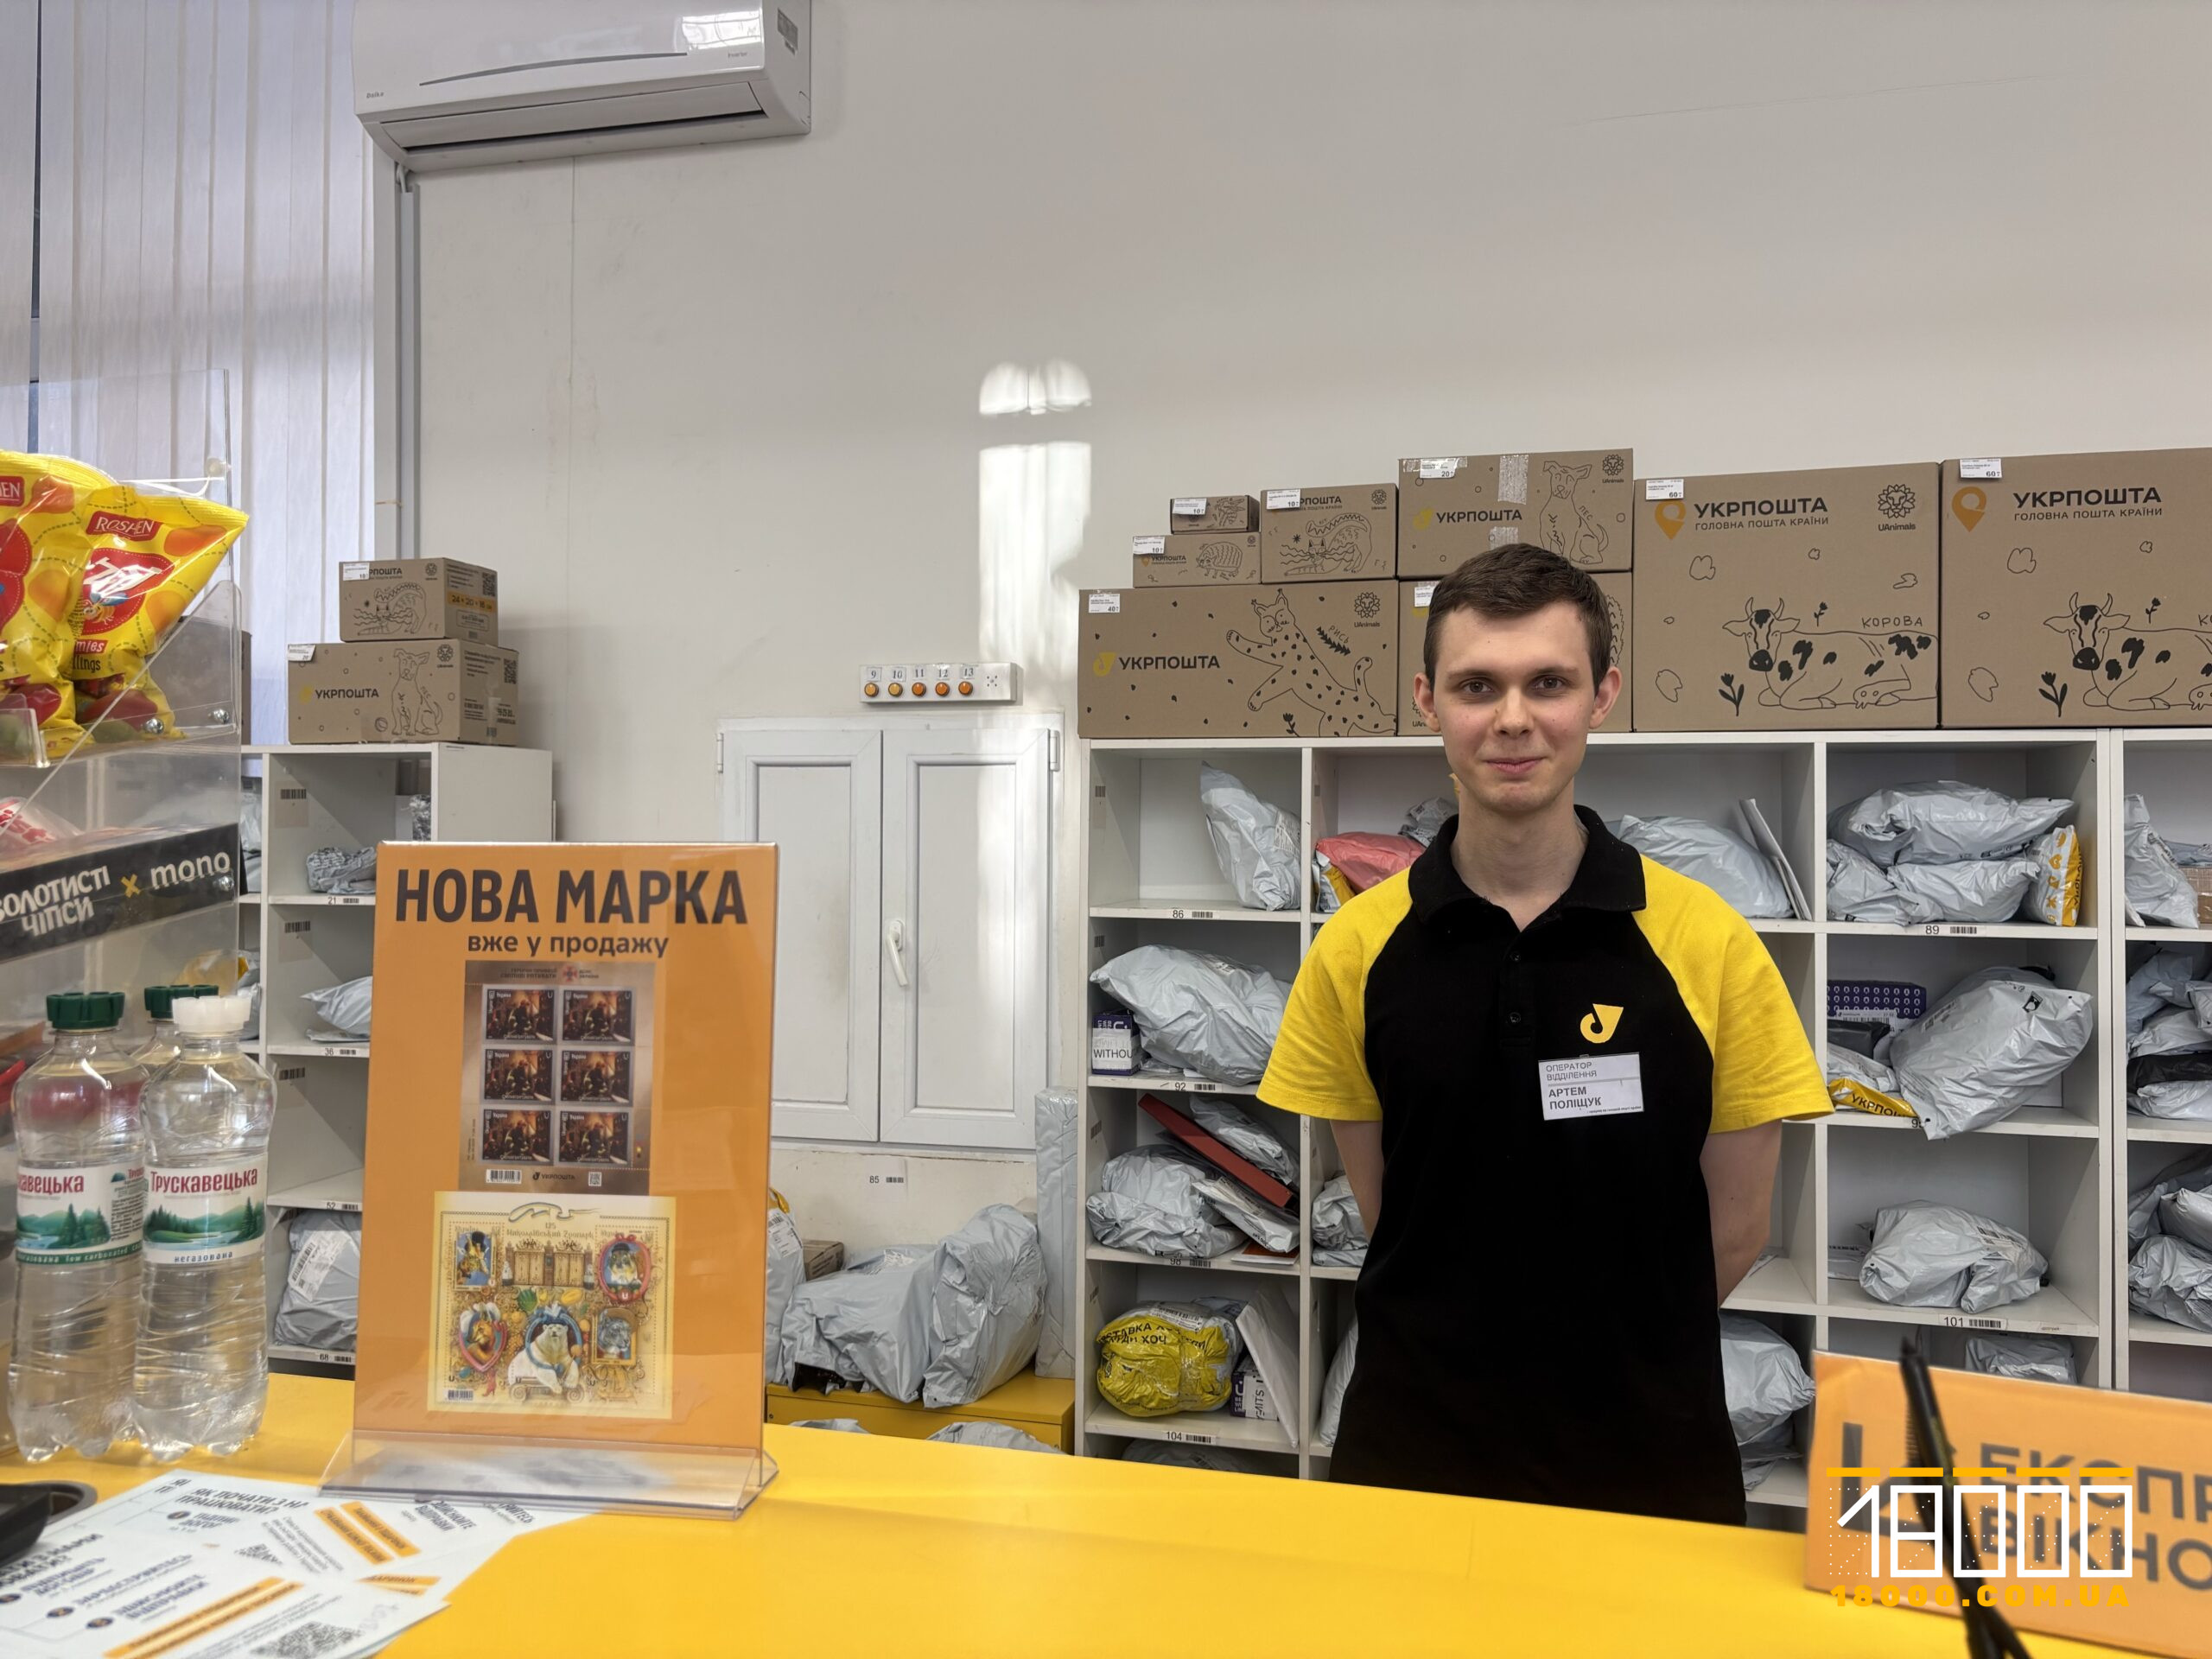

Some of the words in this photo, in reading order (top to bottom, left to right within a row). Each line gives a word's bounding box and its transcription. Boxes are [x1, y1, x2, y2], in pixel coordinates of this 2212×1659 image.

[1300, 496, 1342, 505] РПОШТА
[2012, 487, 2161, 508] УКРПОШТА
[1694, 497, 1827, 518] УКРПОШТА
[1436, 509, 1522, 524] УКРПОШТА
[2014, 511, 2069, 521] ГОЛОВНА
[2073, 509, 2115, 519] ПОШТА
[2120, 507, 2163, 517] КРАЇНИ
[96, 516, 154, 536] ROSHEN
[1694, 520, 1745, 531] ГОЛОВНА
[1748, 518, 1786, 529] ПОШТА
[1790, 517, 1829, 526] КРАЇНИ
[1878, 523, 1916, 531] UAnimals
[369, 567, 403, 576] РПОШТА
[1861, 616, 1923, 629] КОРОВА
[1328, 625, 1350, 644] РИСЬ
[1118, 655, 1220, 670] УКРПОШТА
[871, 670, 876, 679] 9
[893, 670, 902, 679] 10
[915, 668, 925, 677] 11
[938, 669, 949, 677] 12
[963, 667, 974, 677] 13
[315, 688, 379, 699] УКРПОШТА
[150, 851, 231, 890] mono
[327, 896, 337, 906] 21
[395, 868, 540, 924] НОВА
[555, 868, 747, 925] МАРКА
[22, 896, 95, 937] ЧІПСИ
[1173, 910, 1184, 918] 86
[1925, 925, 1940, 935] 89
[467, 934, 518, 953] вже
[526, 936, 541, 957] у
[550, 936, 669, 958] продажу
[1546, 1062, 1592, 1072] ОПЕРАТОР
[1547, 1071, 1597, 1081] ВІДДІЛЕННЯ
[1174, 1082, 1186, 1091] 92
[1548, 1086, 1586, 1097] АРТЕМ
[1549, 1096, 1601, 1110] ПОЛІЩУК
[150, 1168, 257, 1193] Трускавецька
[327, 1202, 336, 1211] 52
[174, 1251, 232, 1262] негазована
[1170, 1257, 1182, 1266] 98
[1943, 1316, 1964, 1327] 101
[1166, 1431, 1183, 1441] 104
[192, 1488, 217, 1497] ЯК
[214, 1491, 277, 1503] ПОЧАТИ
